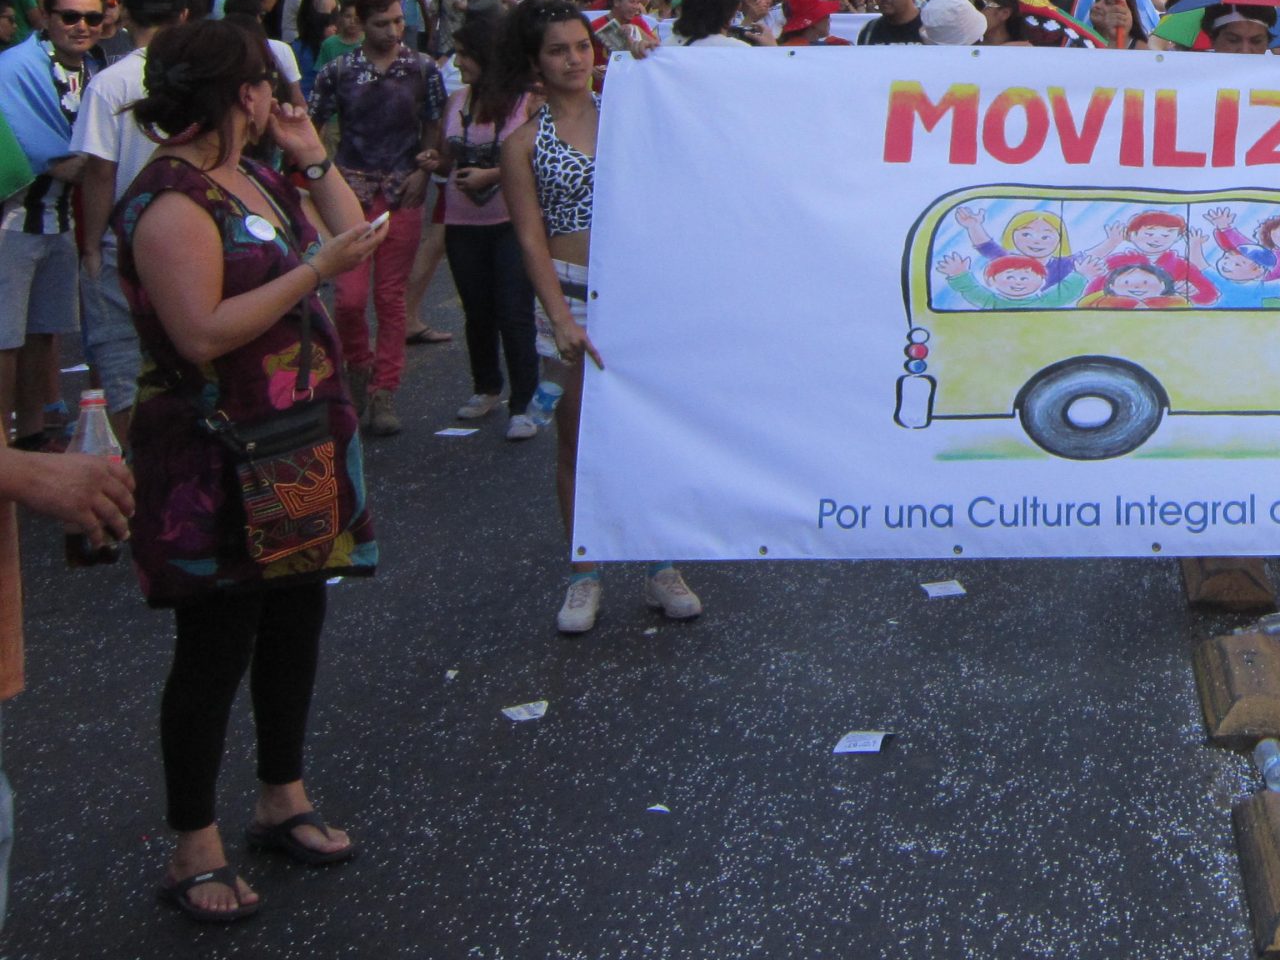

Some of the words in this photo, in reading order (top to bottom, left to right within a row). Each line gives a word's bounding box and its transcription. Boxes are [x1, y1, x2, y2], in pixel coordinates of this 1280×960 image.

[818, 498, 870, 529] Por
[884, 504, 953, 528] una
[967, 496, 1100, 528] Cultura
[1115, 494, 1255, 533] Integral
